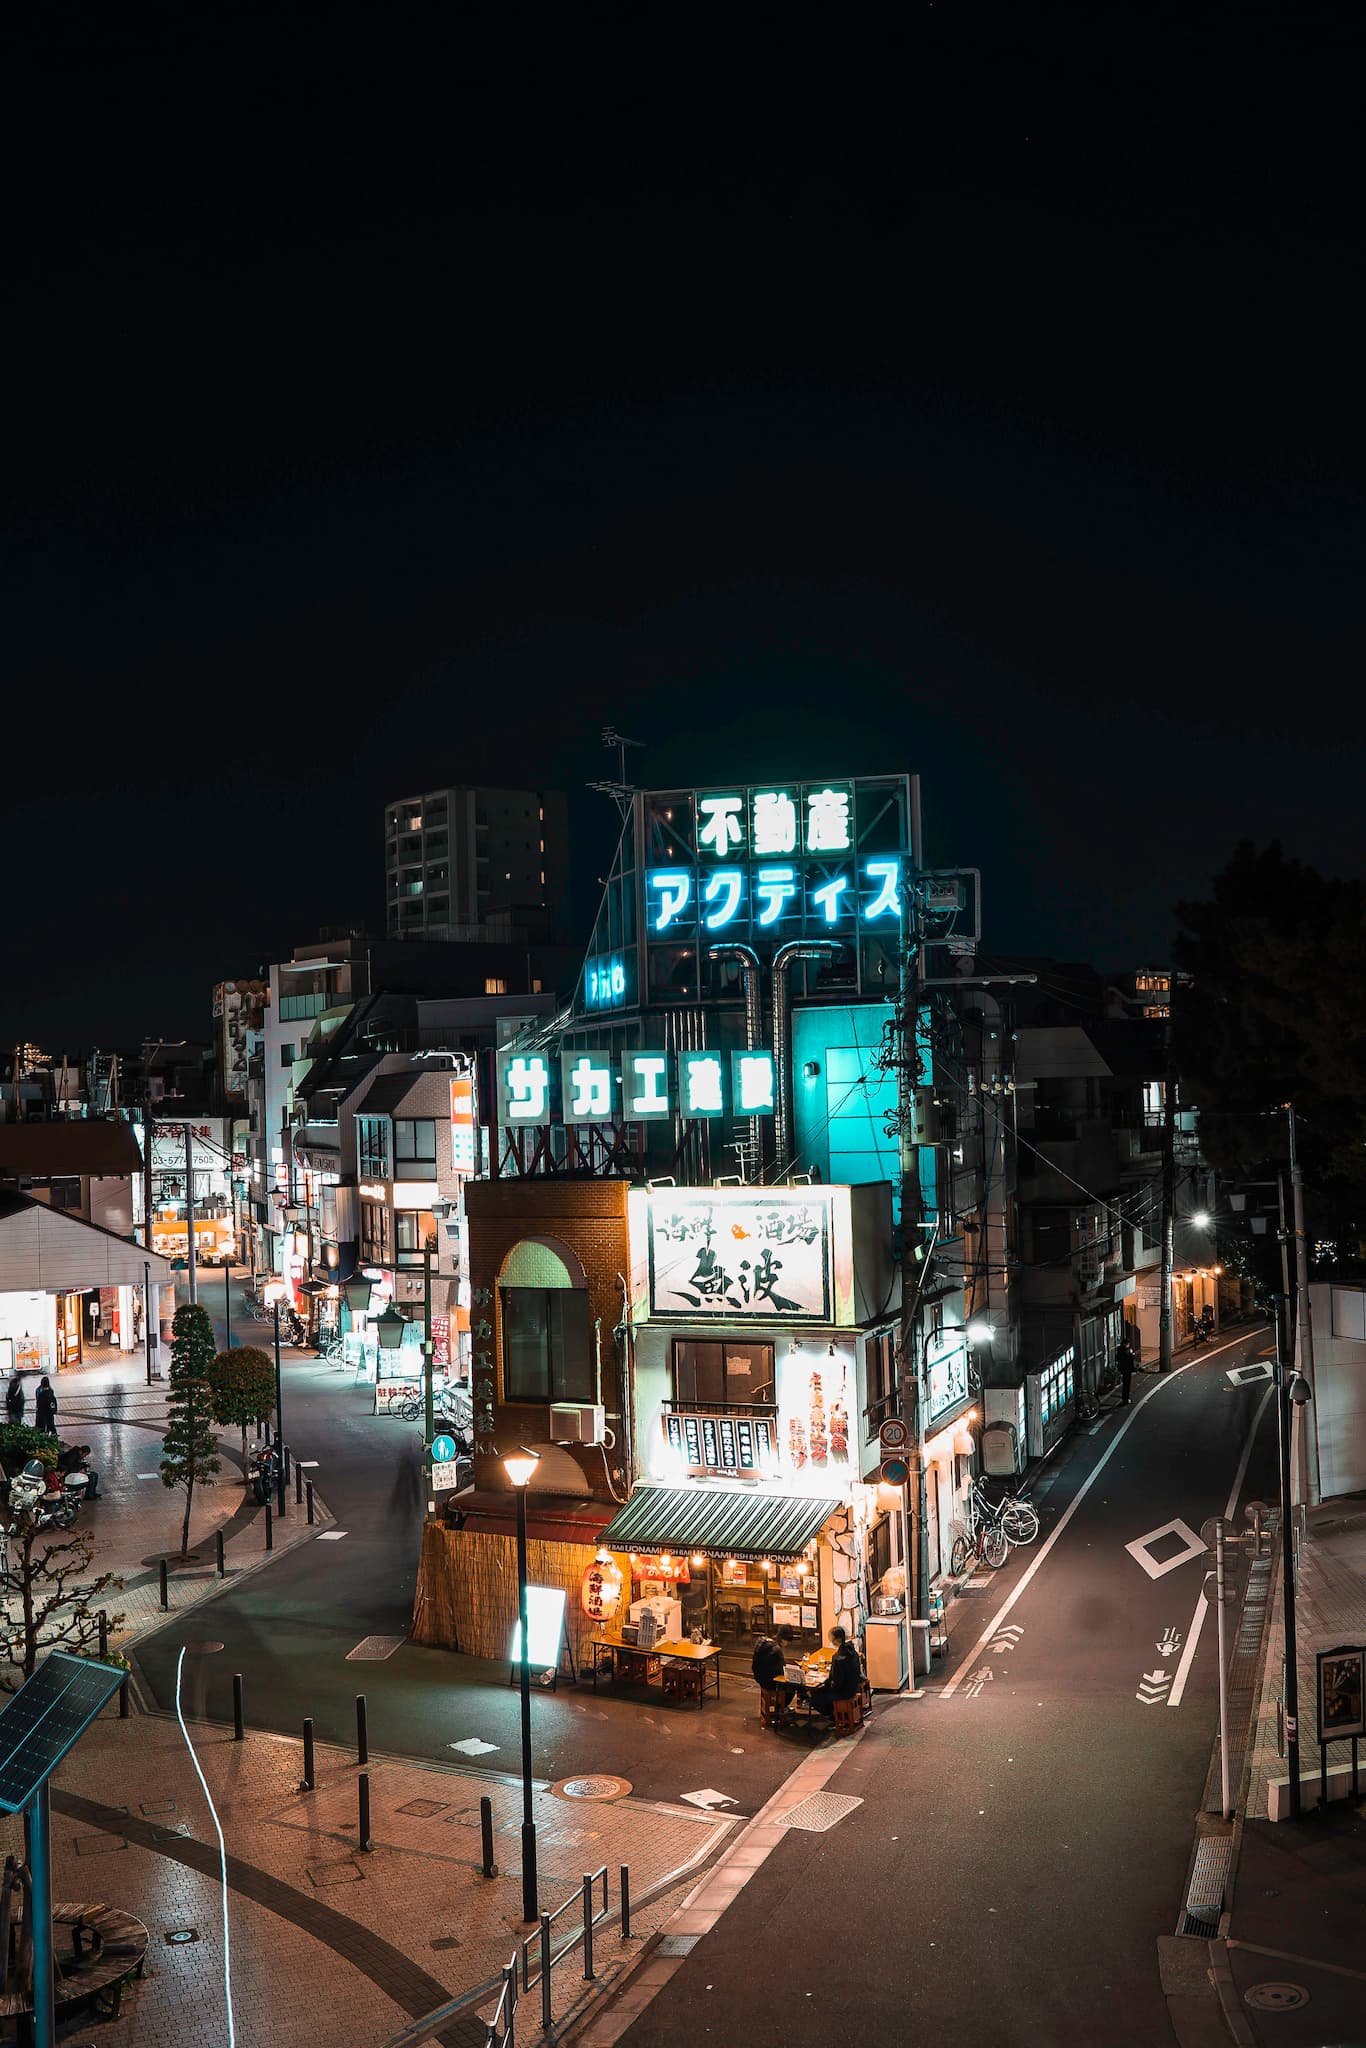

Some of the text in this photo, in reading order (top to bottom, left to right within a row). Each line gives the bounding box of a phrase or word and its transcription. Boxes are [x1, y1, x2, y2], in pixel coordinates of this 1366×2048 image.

[700, 789, 850, 856] 不動産
[652, 862, 903, 930] アクティス
[508, 1057, 774, 1118] サカエ
[656, 1206, 820, 1249] 海鮮 酒場
[667, 1247, 809, 1312] 魚波
[886, 1427, 902, 1440] 20
[625, 1545, 662, 1554] UONAMI
[692, 1550, 732, 1559] UONAMI
